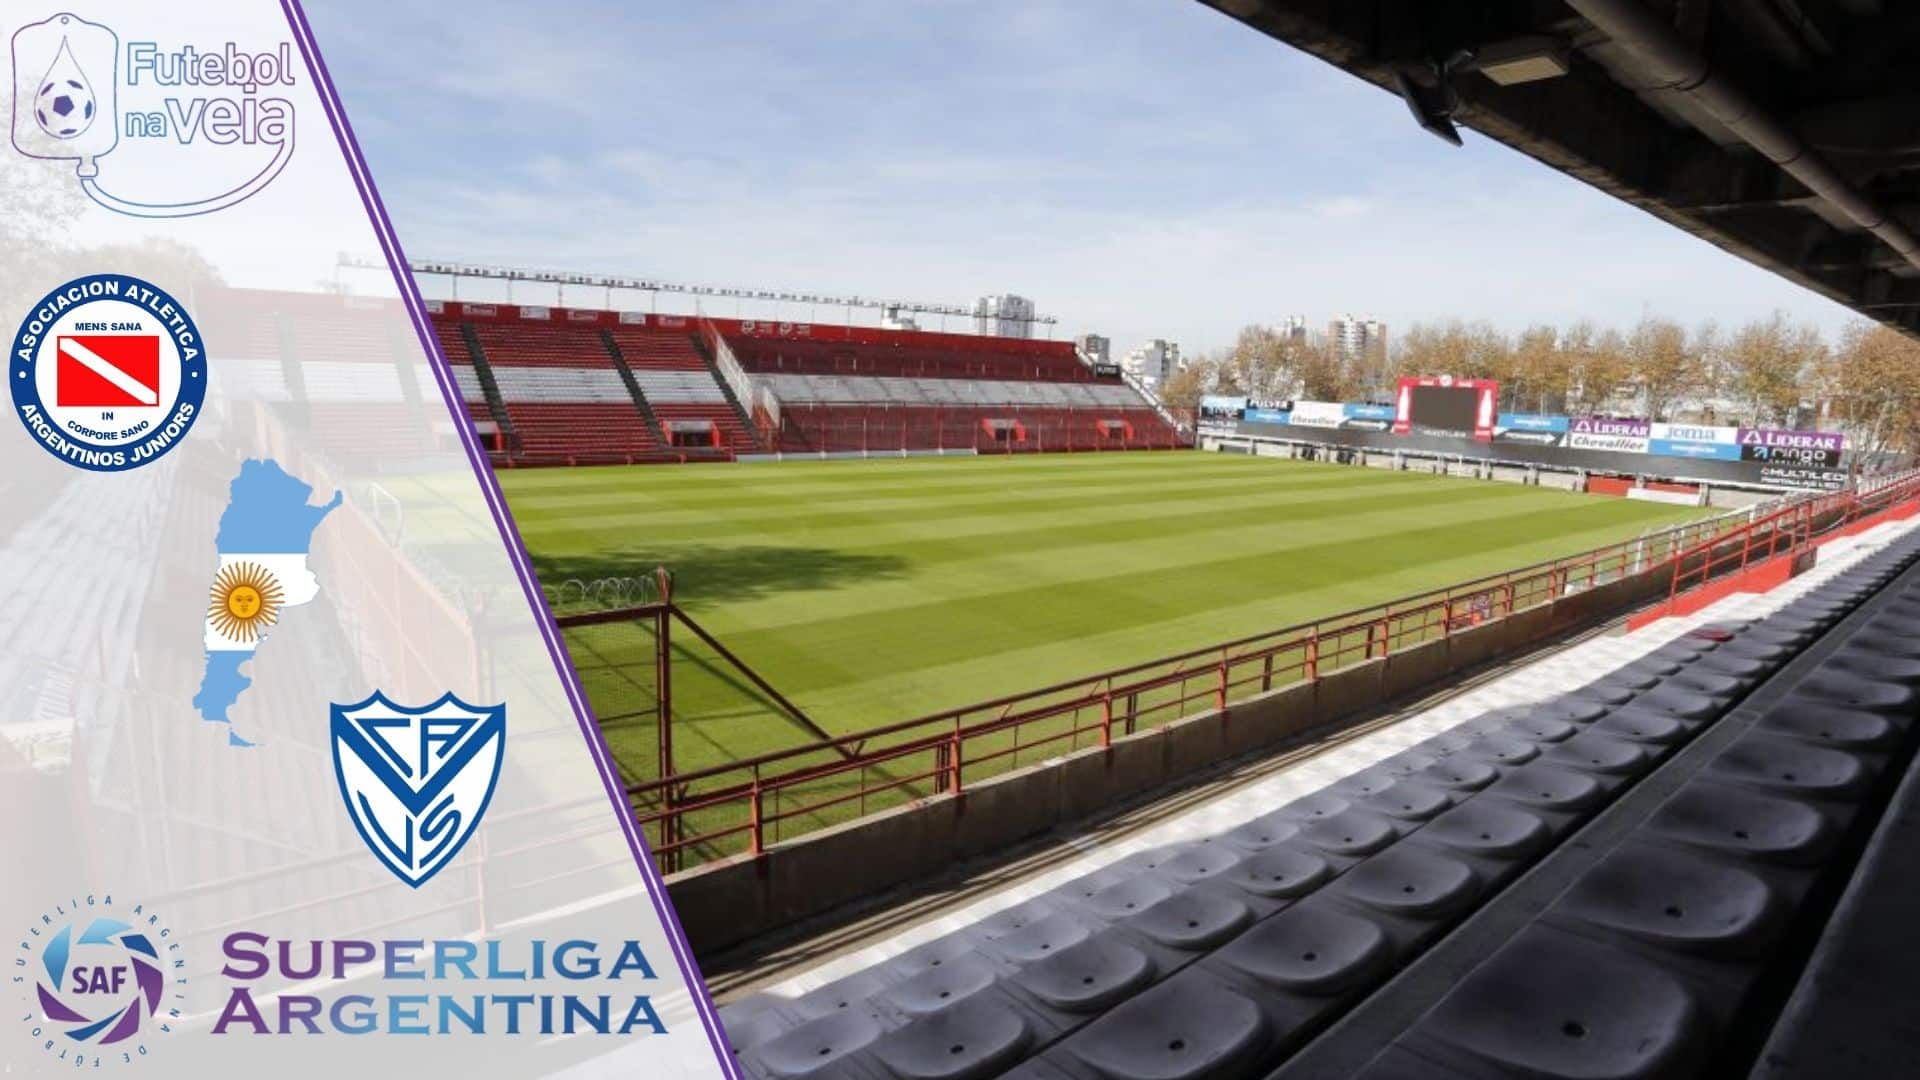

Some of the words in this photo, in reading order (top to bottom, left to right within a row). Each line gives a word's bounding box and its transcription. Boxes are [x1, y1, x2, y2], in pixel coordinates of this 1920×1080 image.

[1593, 423, 1649, 436] LIDERAR
[1573, 435, 1645, 449] Chevallier
[1766, 431, 1836, 450] LIDERAR
[1772, 447, 1826, 463] ringo
